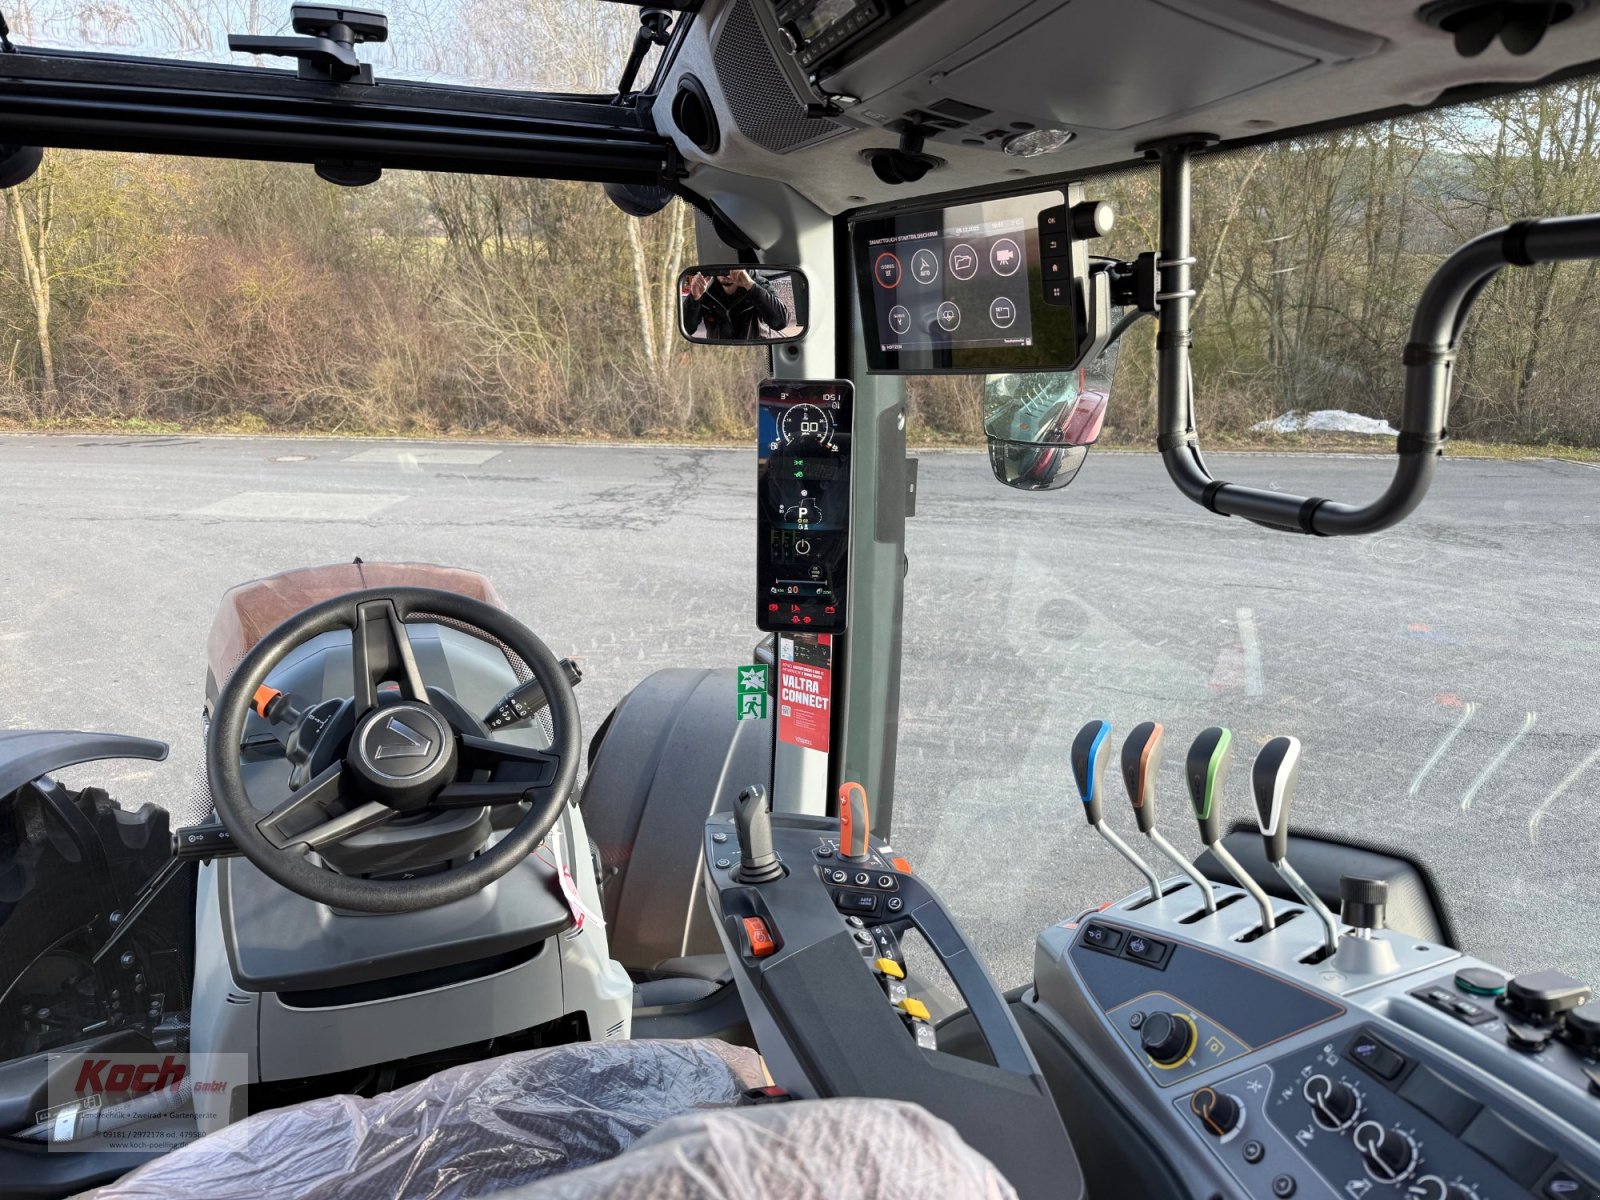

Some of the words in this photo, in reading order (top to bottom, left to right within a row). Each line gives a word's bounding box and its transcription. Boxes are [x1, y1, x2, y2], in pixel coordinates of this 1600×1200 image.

[798, 507, 808, 519] P
[782, 673, 819, 694] VALTRA
[781, 687, 829, 711] CONNECT
[880, 937, 887, 945] 4
[886, 950, 893, 959] 3
